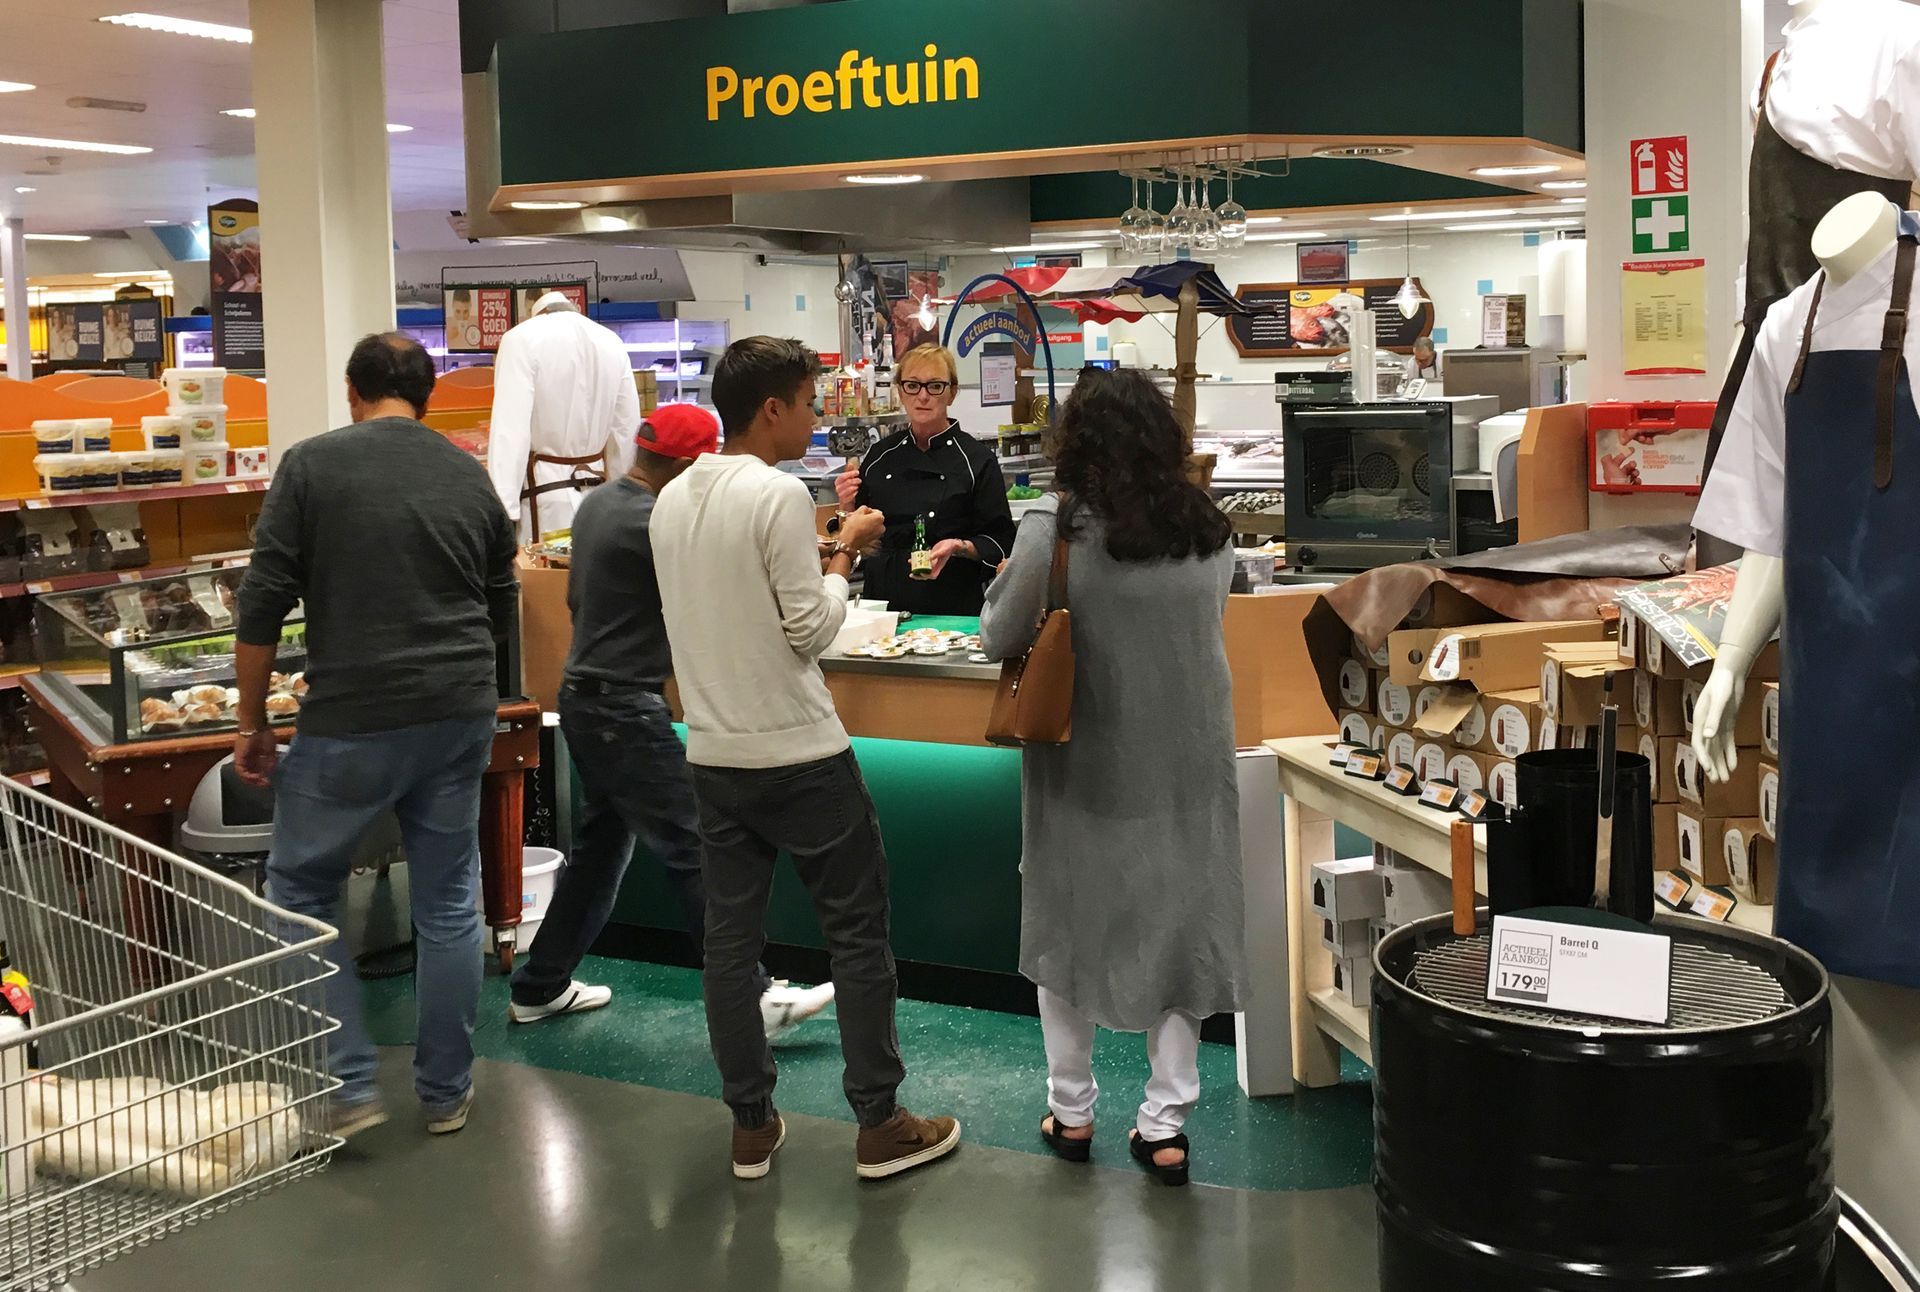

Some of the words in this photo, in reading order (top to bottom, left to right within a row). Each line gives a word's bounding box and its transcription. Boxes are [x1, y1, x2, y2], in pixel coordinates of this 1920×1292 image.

[706, 43, 979, 121] Proeftuin
[482, 300, 507, 317] 25%
[482, 318, 507, 333] GOED
[964, 313, 997, 347] actueel
[997, 317, 1031, 346] aanbod
[1612, 587, 1713, 667] Exclusief
[1502, 943, 1549, 957] ACTUEEL
[1560, 936, 1589, 949] Barrel
[1591, 940, 1599, 950] Q
[1502, 952, 1548, 965] AANBOD
